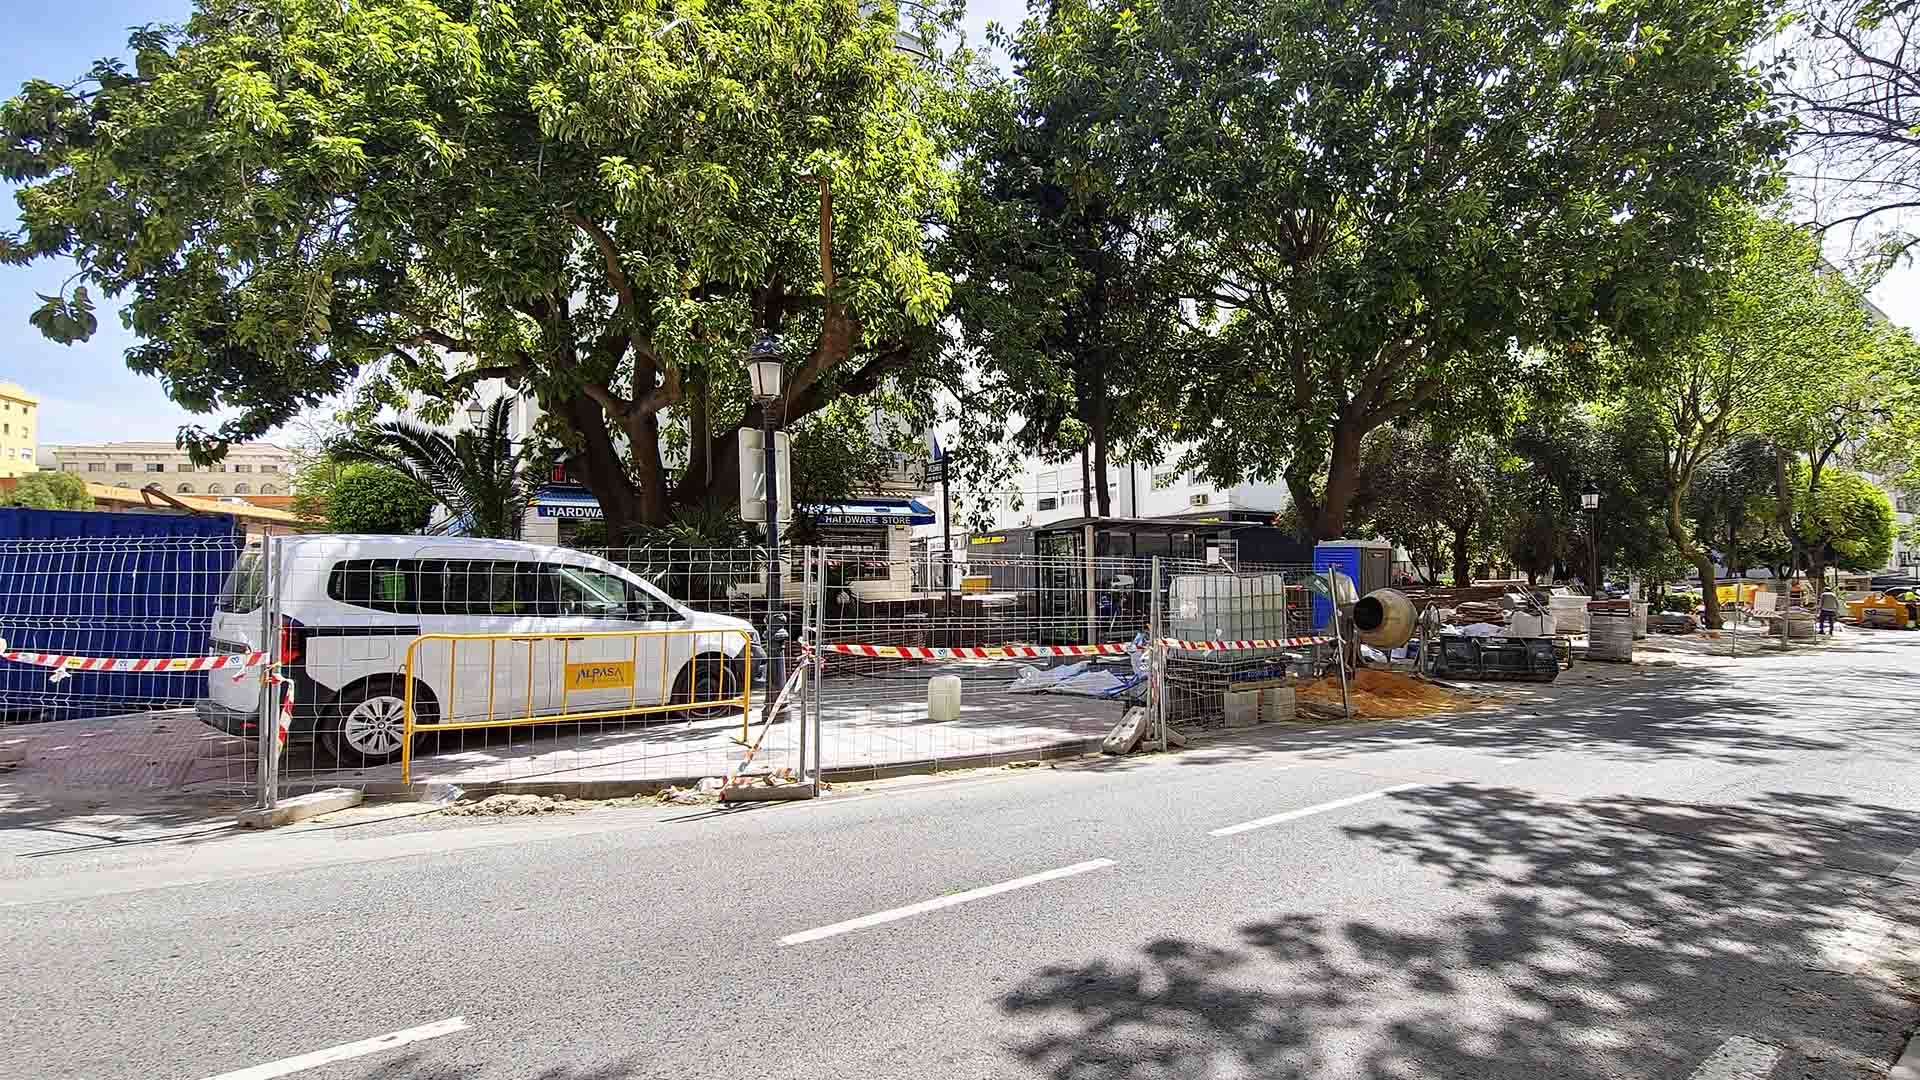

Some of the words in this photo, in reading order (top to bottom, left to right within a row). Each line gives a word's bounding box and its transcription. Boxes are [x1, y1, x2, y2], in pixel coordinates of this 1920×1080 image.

[546, 507, 604, 518] HARDWA
[882, 516, 911, 525] STORE
[576, 667, 624, 685] ALPASA
